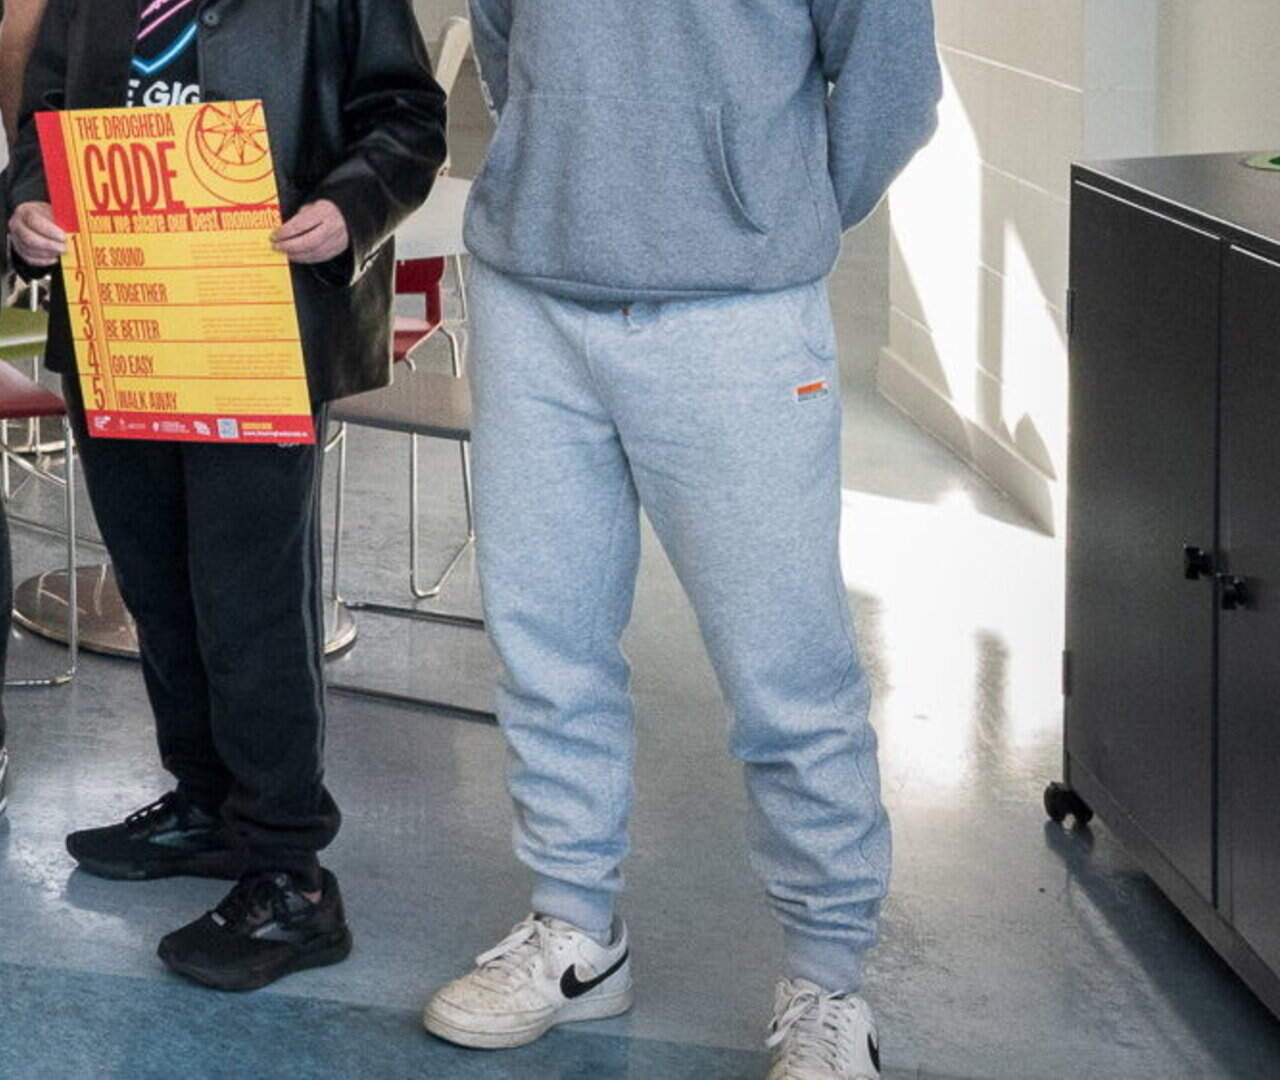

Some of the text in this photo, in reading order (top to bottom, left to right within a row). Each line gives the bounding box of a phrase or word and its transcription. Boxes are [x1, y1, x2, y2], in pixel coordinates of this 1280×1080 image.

[75, 112, 175, 141] THE DROGHEDA
[83, 141, 184, 213] CODE
[70, 235, 144, 269] 1 BE SOUND
[75, 271, 168, 305] 2 BE TOGETHER
[80, 306, 160, 340] 3 BE BETTER
[87, 341, 154, 376] 4 GO EASY
[92, 377, 177, 411] 5 WALK AWAY
